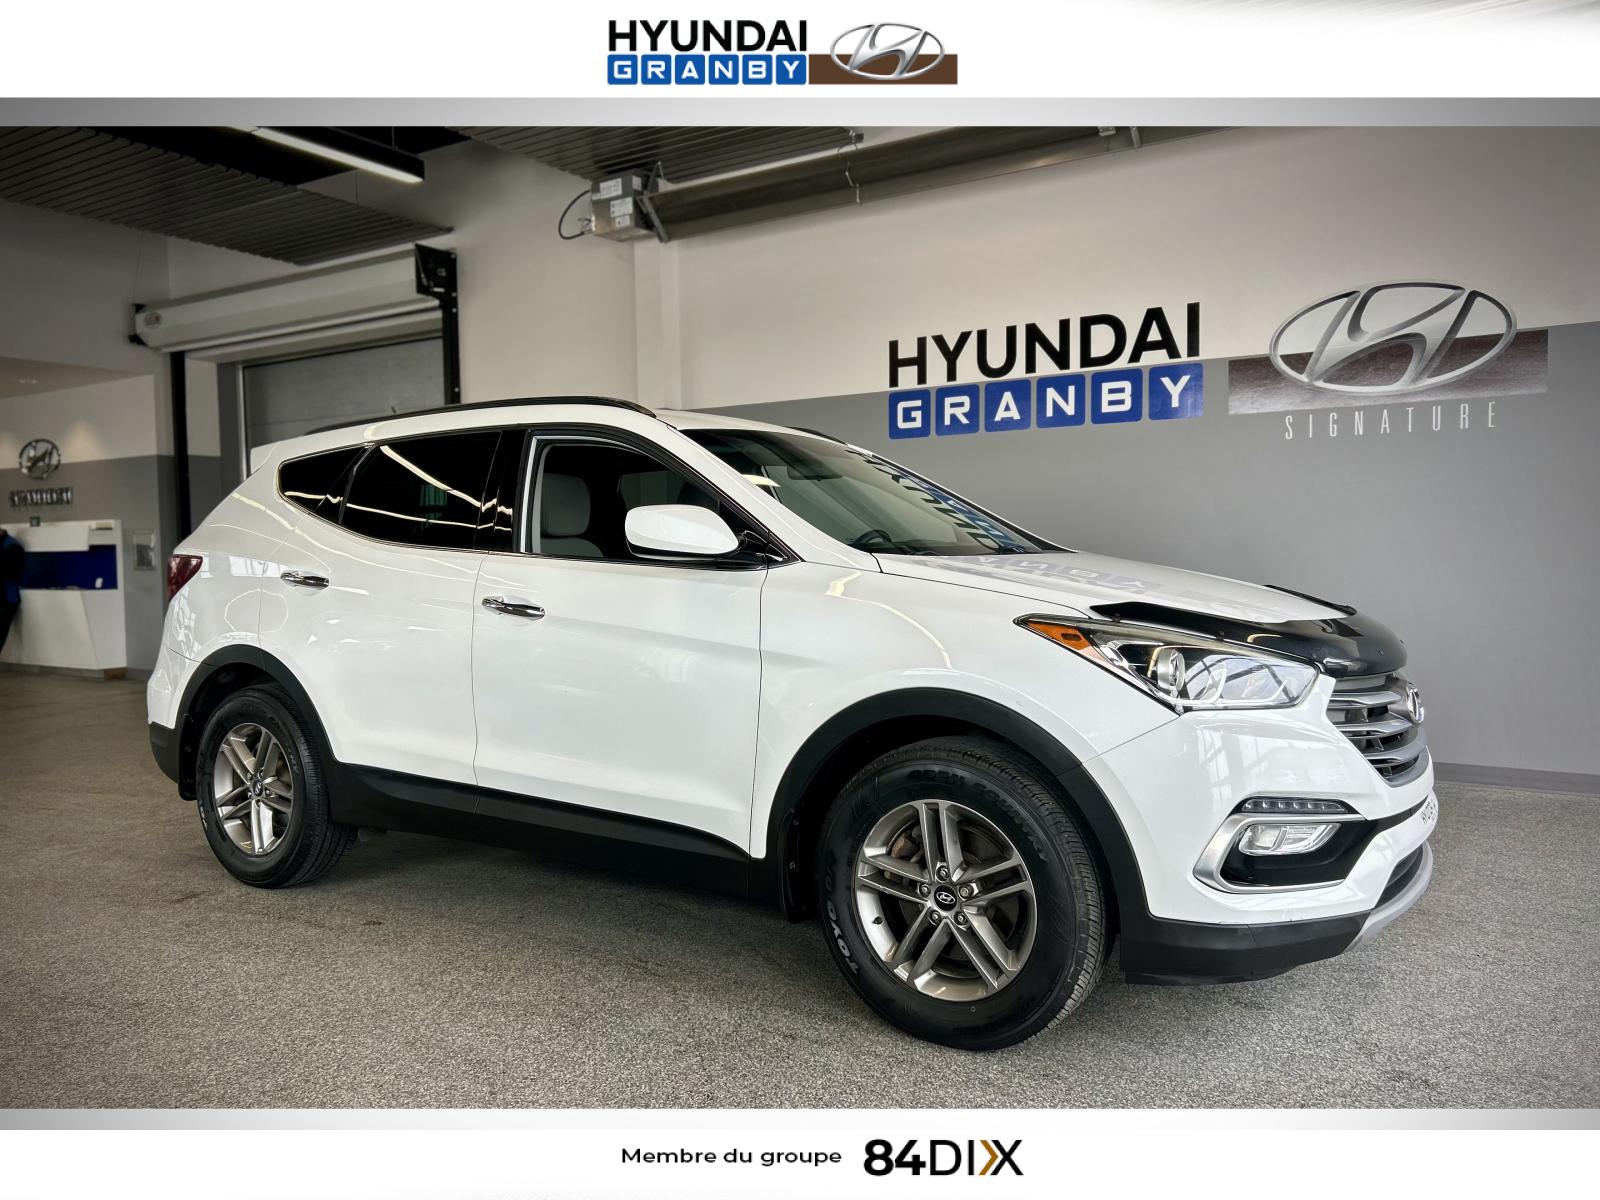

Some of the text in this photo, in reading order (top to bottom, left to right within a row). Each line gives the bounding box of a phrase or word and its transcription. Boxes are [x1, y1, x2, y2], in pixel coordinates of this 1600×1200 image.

[888, 302, 1200, 388] HYUNDAI
[896, 374, 1192, 430] GRANBY
[1284, 400, 1498, 441] SIGNATURE
[826, 900, 860, 975] TOYO
